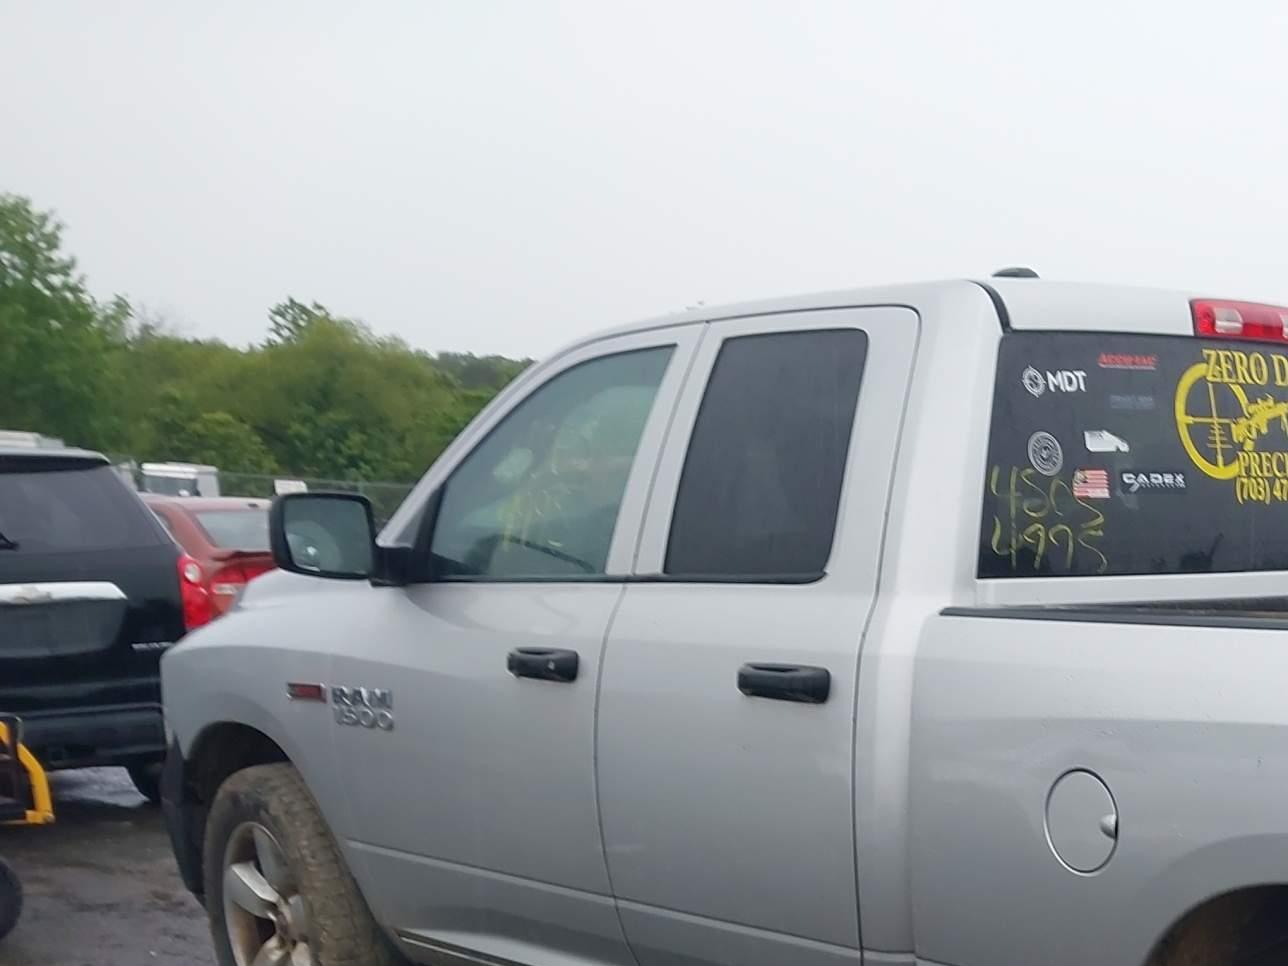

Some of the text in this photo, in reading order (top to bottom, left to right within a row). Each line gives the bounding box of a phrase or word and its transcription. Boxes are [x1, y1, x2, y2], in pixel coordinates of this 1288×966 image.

[1202, 348, 1268, 386] ZERO
[1046, 369, 1088, 393] MDT
[1121, 471, 1186, 493] CADEX
[1235, 477, 1271, 505] (703)
[331, 686, 393, 711] RAM
[332, 705, 395, 732] 1500
